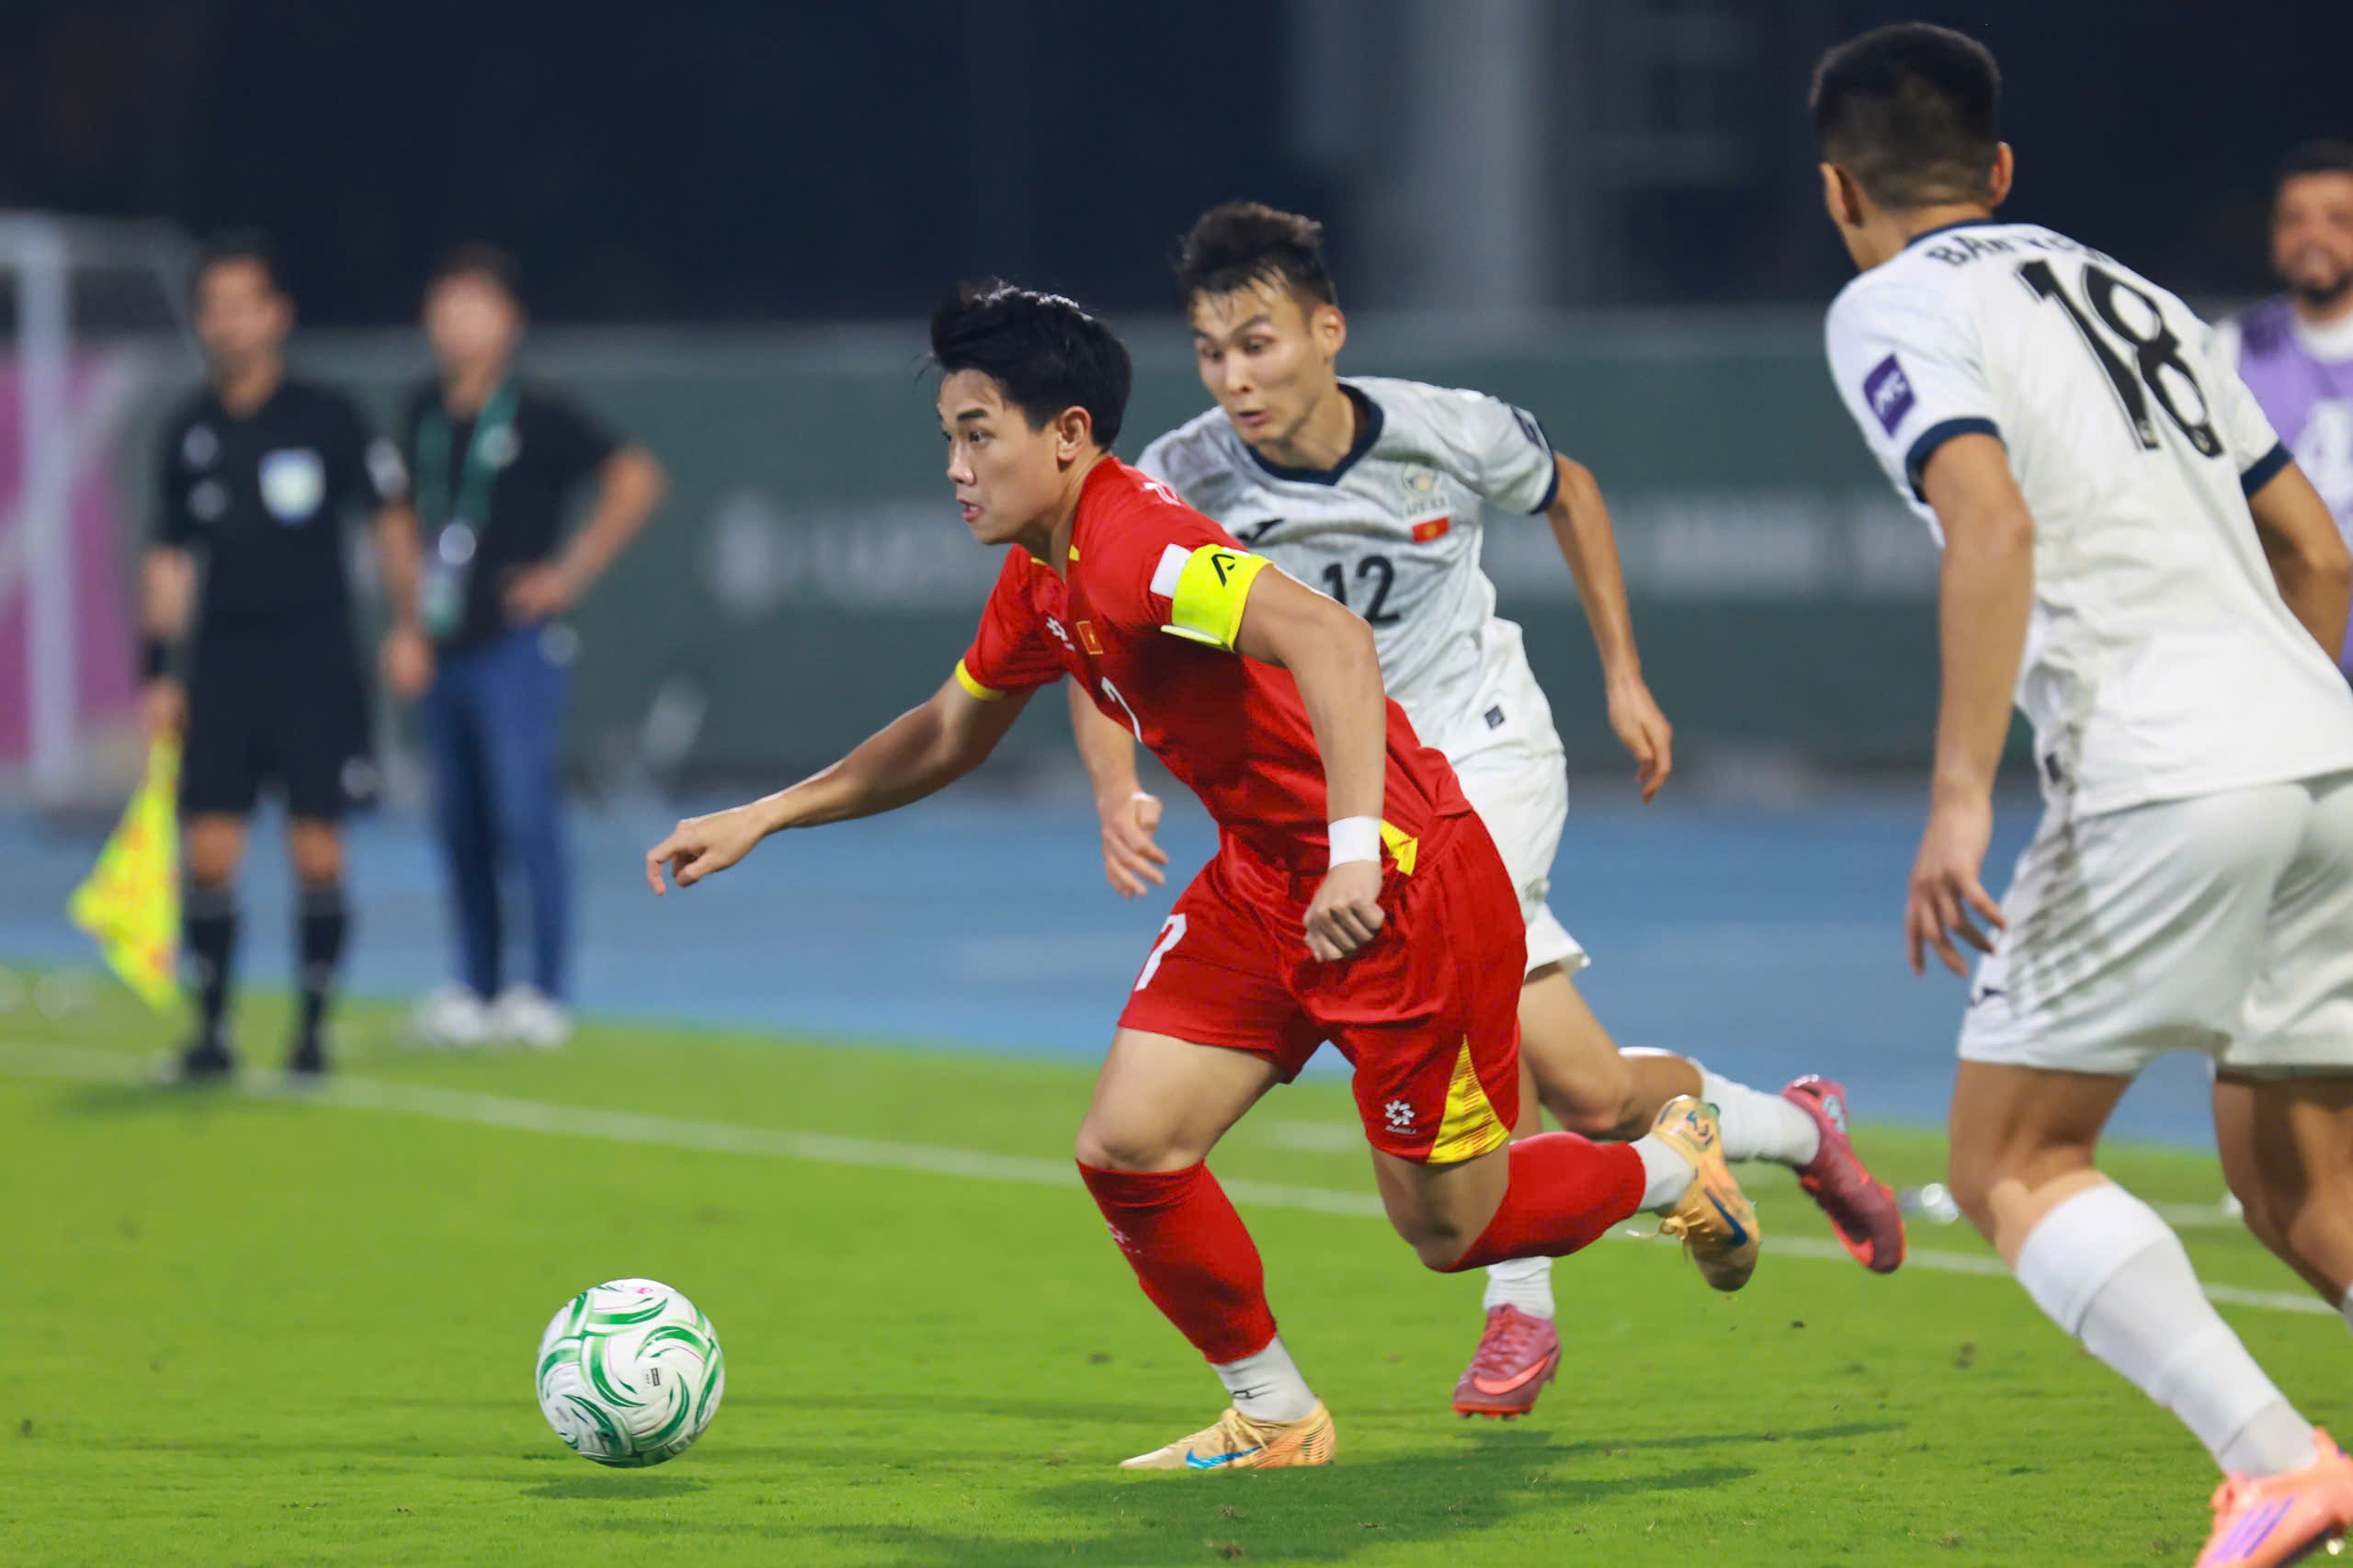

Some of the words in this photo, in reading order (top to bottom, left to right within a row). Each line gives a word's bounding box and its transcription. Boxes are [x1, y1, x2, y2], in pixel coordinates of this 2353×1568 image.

[2015, 258, 2225, 458] 18
[1323, 555, 1401, 628] 12
[1134, 913, 1188, 992] 7
